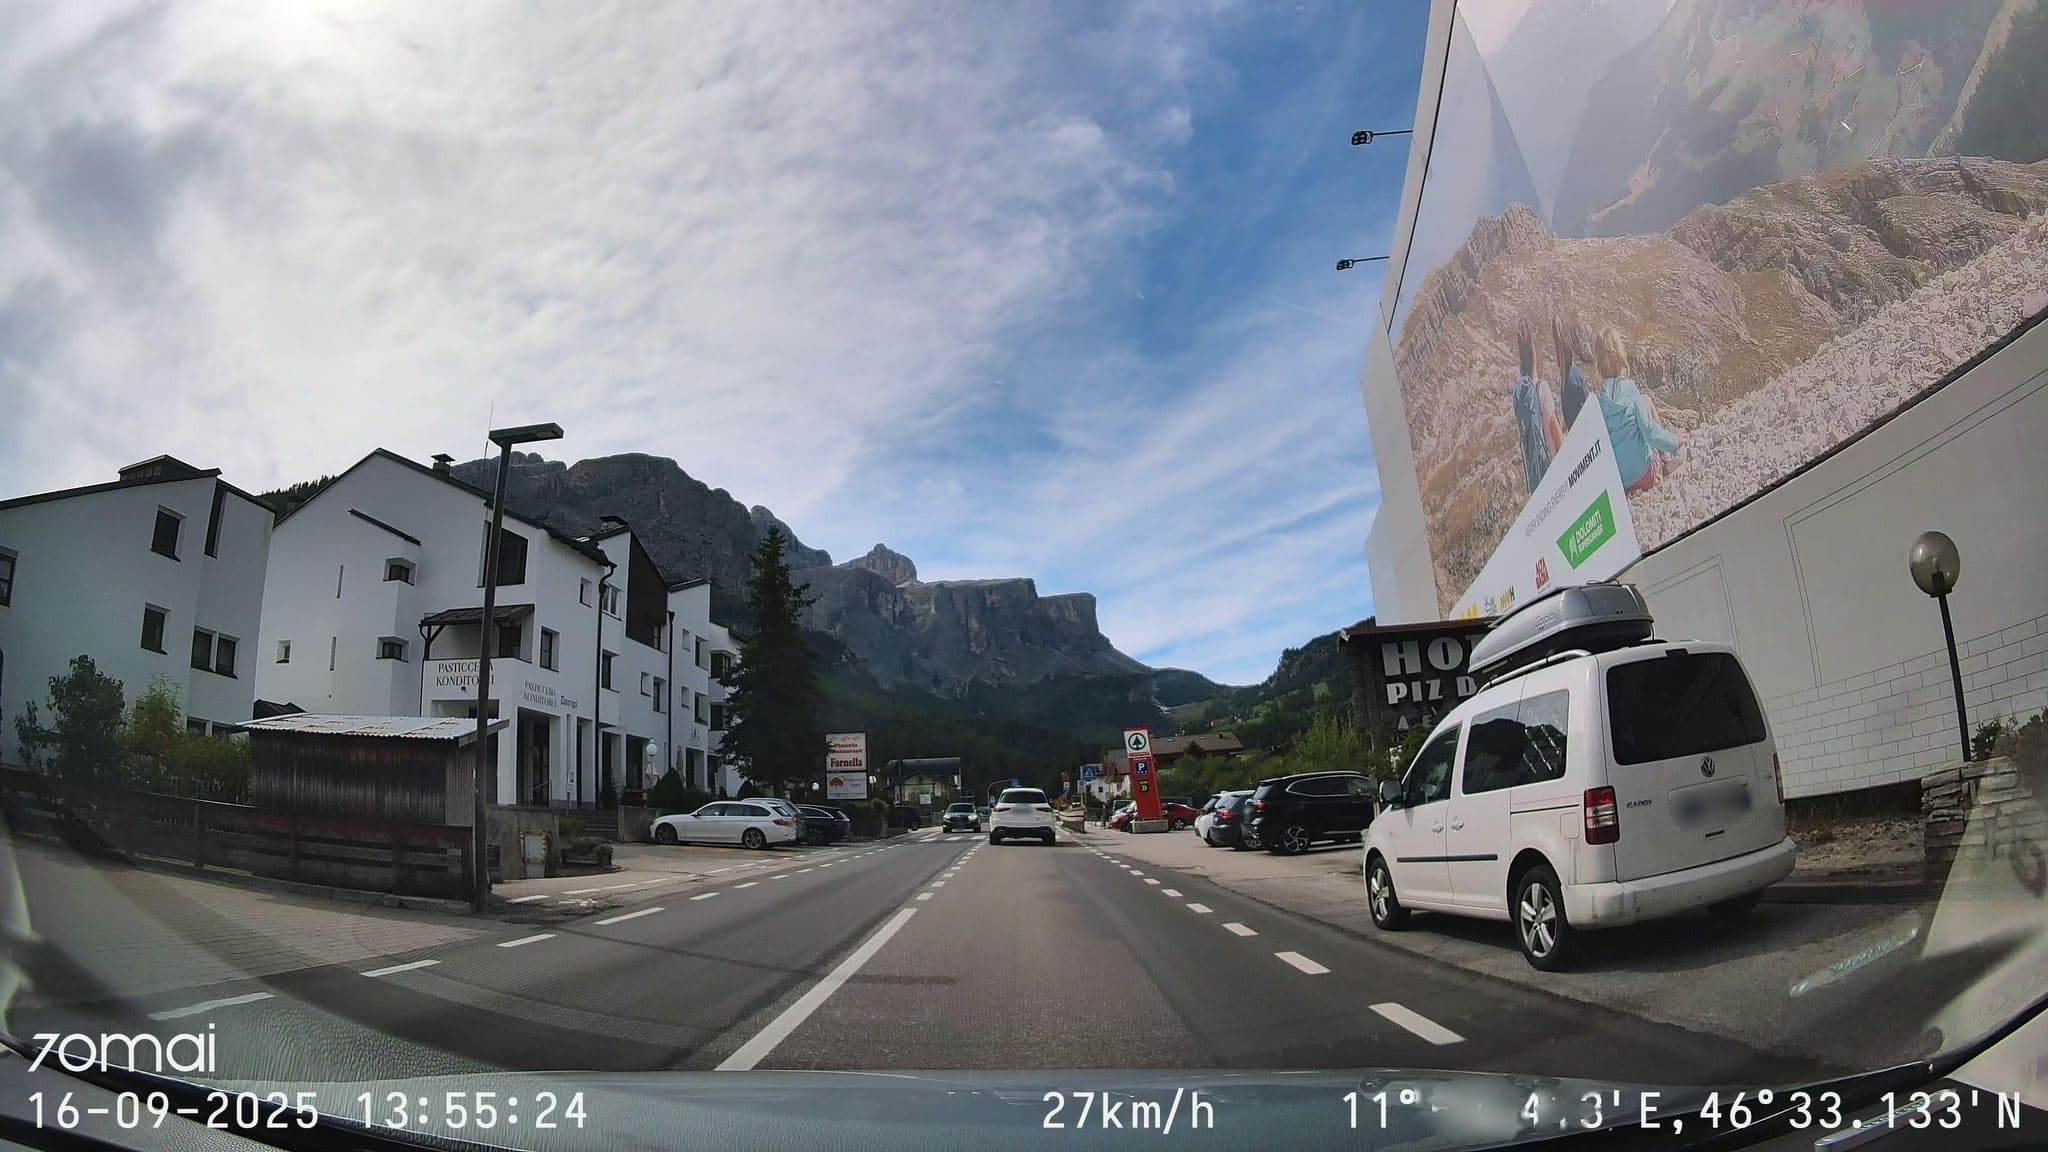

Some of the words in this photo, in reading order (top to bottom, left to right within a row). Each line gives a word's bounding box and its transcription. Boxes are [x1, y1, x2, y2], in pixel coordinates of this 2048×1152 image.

[1568, 438, 1602, 488] MOVIMENT.IT
[438, 661, 494, 673] PASTICCEA
[436, 674, 494, 686] KONDITOI
[1386, 679, 1443, 704] PIZ
[830, 757, 863, 768] Fornella
[1626, 799, 1653, 809] CADDY
